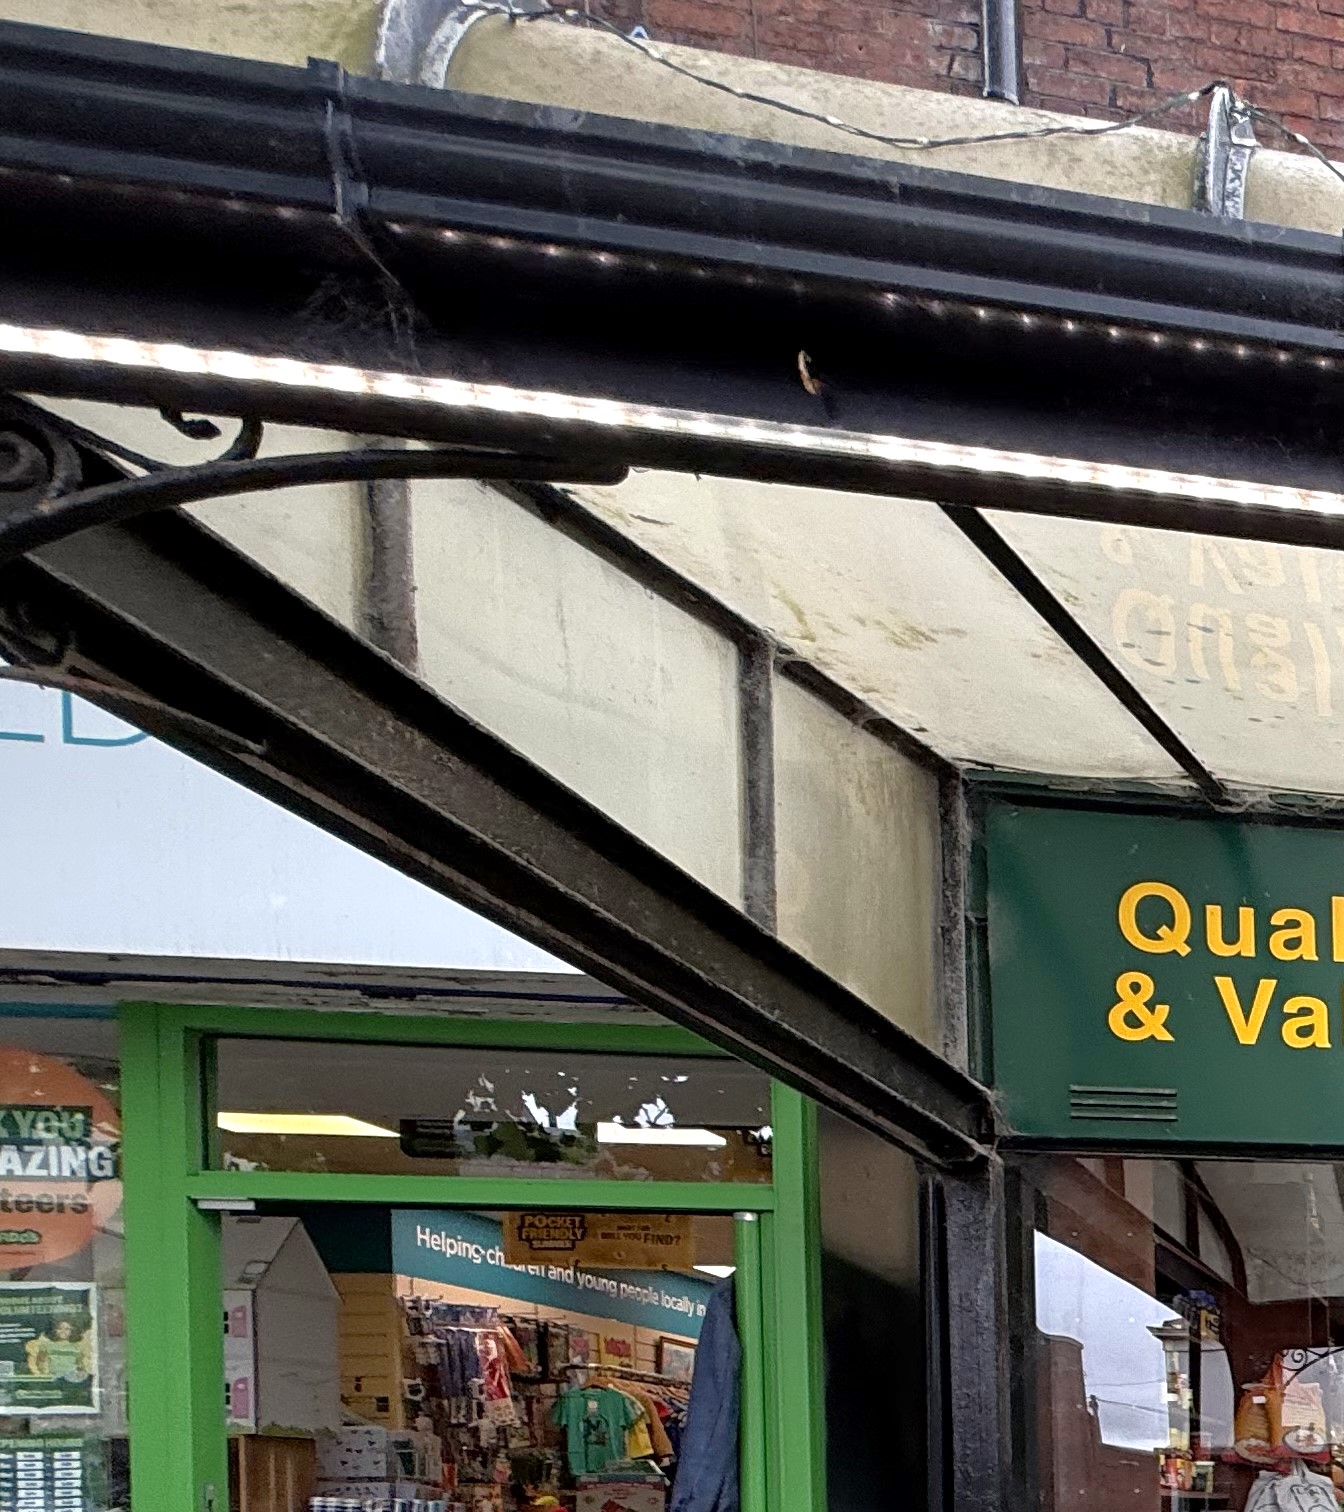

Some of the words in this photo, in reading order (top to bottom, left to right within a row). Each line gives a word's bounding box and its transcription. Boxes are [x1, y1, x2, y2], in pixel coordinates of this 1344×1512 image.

[1107, 972, 1175, 1042] &
[522, 1228, 585, 1240] FRIENDLY
[525, 1215, 581, 1228] POCKET
[416, 1225, 482, 1264] Helping
[547, 1265, 575, 1284] and
[575, 1271, 617, 1298] young
[619, 1281, 659, 1306] people
[661, 1290, 695, 1317] locally
